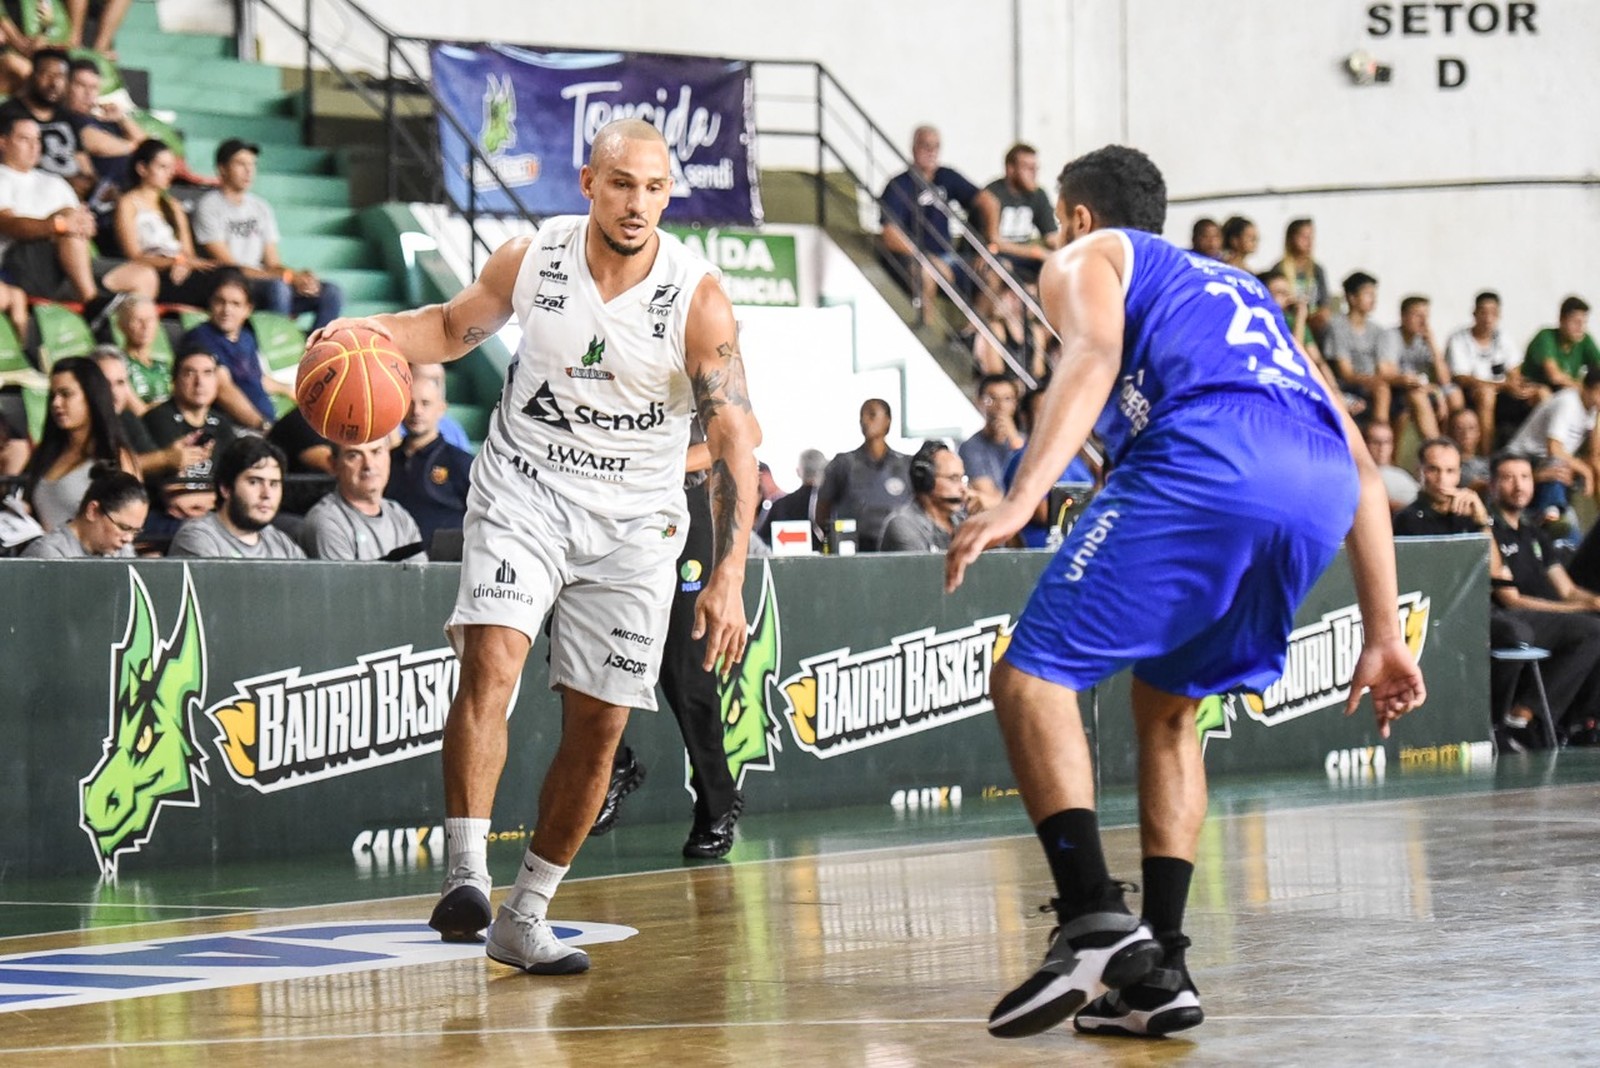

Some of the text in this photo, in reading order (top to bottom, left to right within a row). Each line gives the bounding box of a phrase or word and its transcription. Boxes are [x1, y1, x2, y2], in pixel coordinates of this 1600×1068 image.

[1367, 3, 1537, 37] SETOR
[1438, 58, 1468, 88] D
[672, 227, 776, 273] AÍDA
[574, 401, 665, 431] sendi
[547, 443, 630, 472] LWART
[473, 584, 534, 605] dinâmica
[815, 631, 997, 740] BAURU BASKET
[255, 658, 460, 772] BAURU BASK
